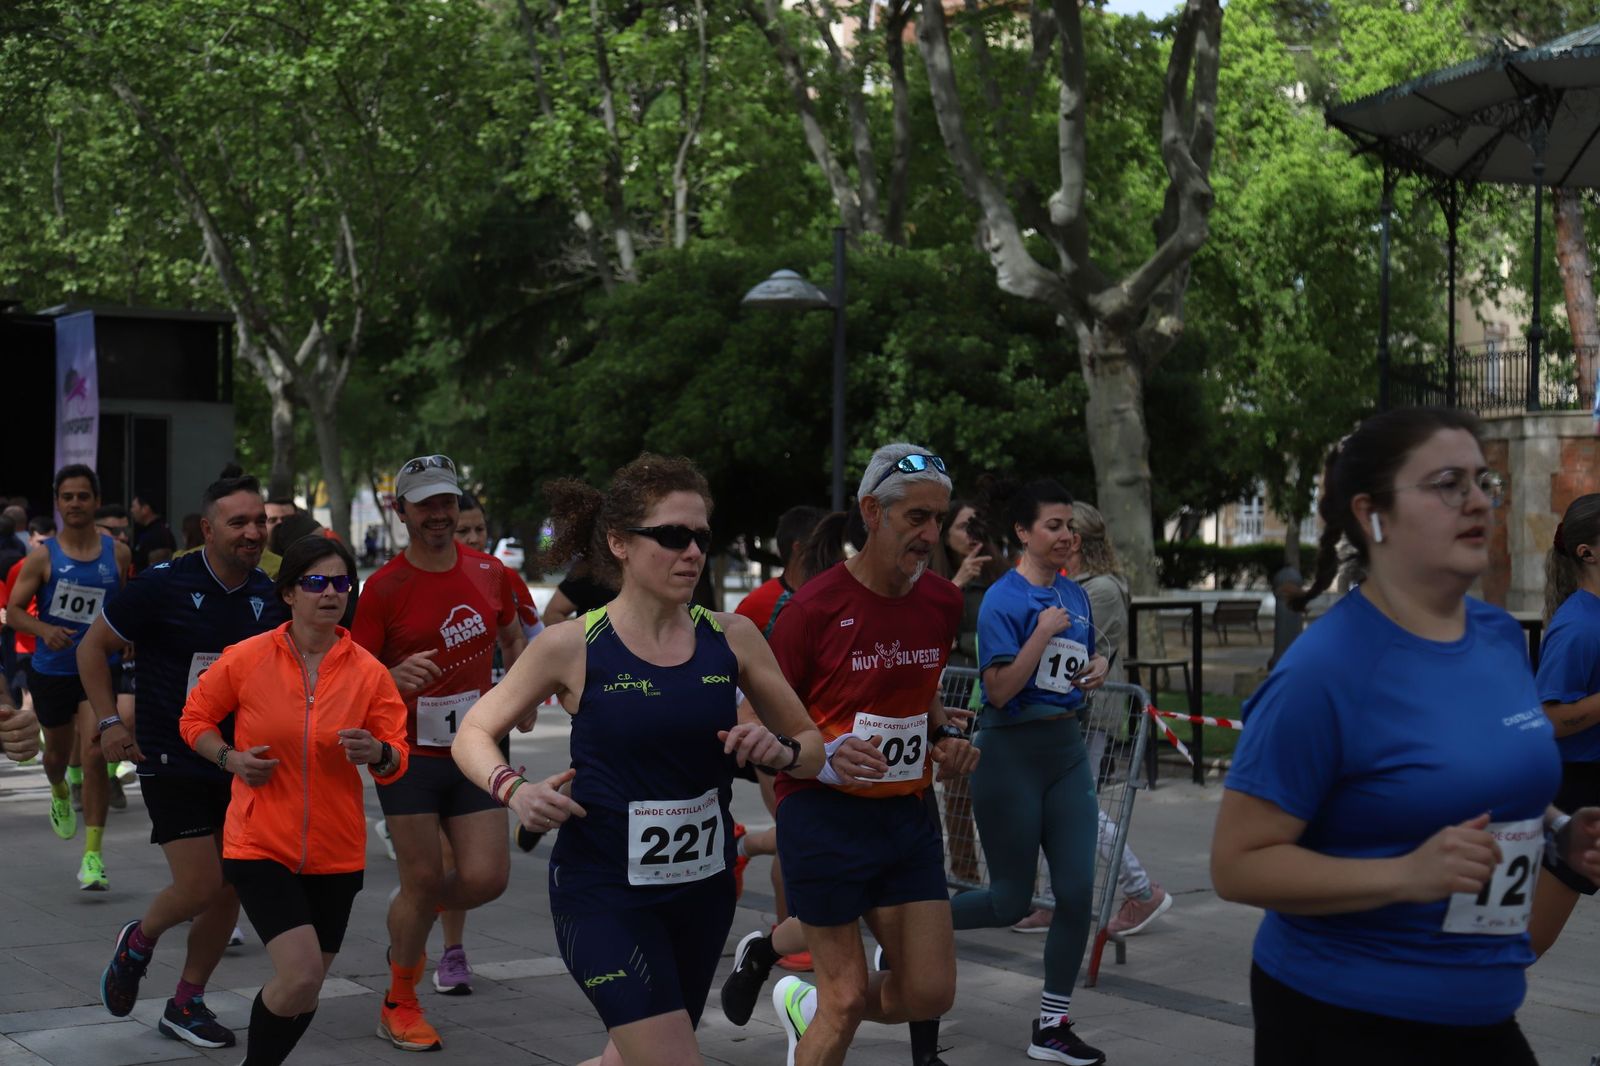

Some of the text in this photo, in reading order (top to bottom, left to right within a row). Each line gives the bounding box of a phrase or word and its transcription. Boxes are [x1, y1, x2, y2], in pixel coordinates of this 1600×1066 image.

[59, 593, 97, 615] 101
[440, 614, 482, 639] VALDO
[445, 622, 487, 649] RADAS
[852, 648, 940, 671] MUY SILVESTRE
[1049, 653, 1085, 681] 19
[617, 673, 633, 681] C.D.
[866, 735, 922, 767] 03
[653, 808, 664, 816] DE
[665, 805, 702, 816] CASTILLA
[640, 815, 718, 866] 227
